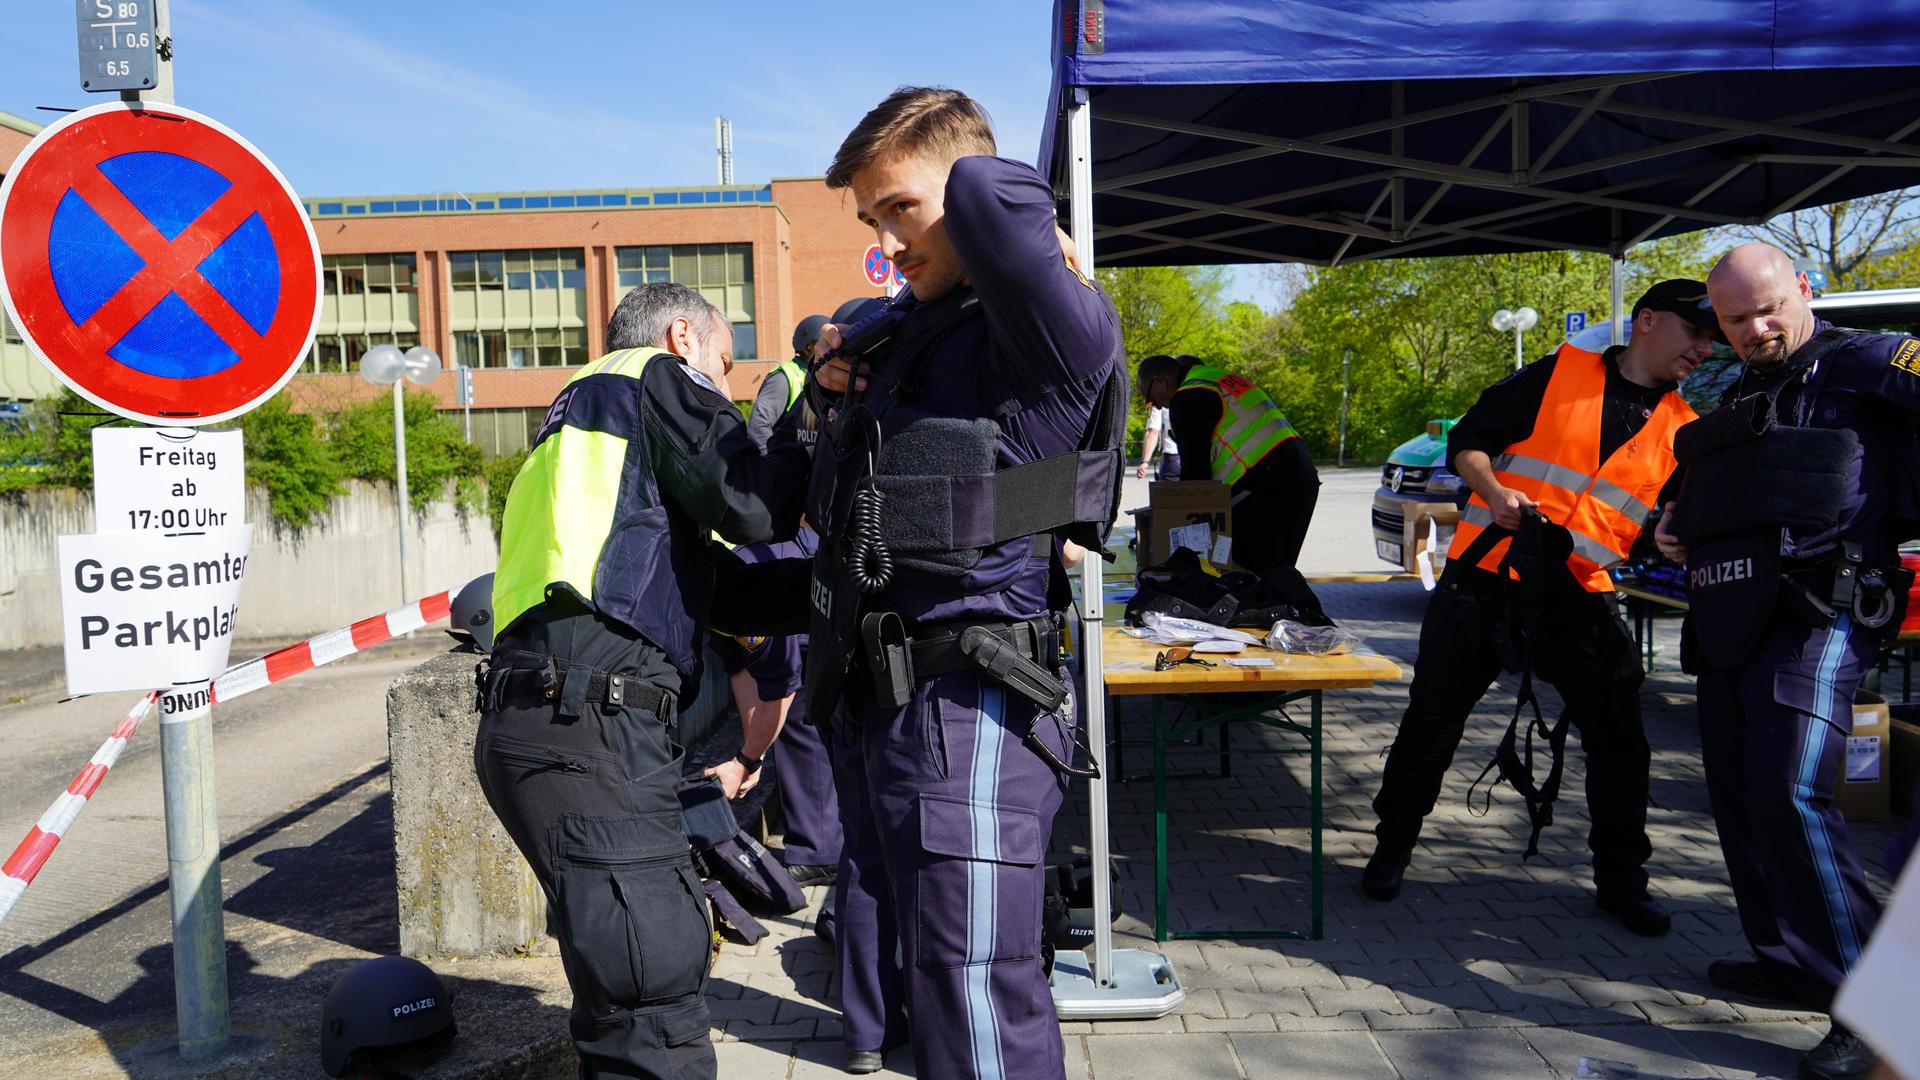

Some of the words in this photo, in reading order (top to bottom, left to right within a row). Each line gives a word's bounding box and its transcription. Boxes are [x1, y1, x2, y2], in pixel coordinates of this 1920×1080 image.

[95, 0, 113, 18] S
[126, 33, 149, 48] 0,6
[107, 61, 130, 76] 6,5
[1570, 314, 1582, 331] P
[139, 446, 216, 470] Freitag
[171, 478, 197, 497] ab
[128, 509, 190, 529] 17:00
[195, 508, 228, 527] Uhr
[1691, 558, 1752, 589] POLIZEI
[80, 603, 238, 651] Parkplat
[393, 998, 435, 1017] POLIZEI
